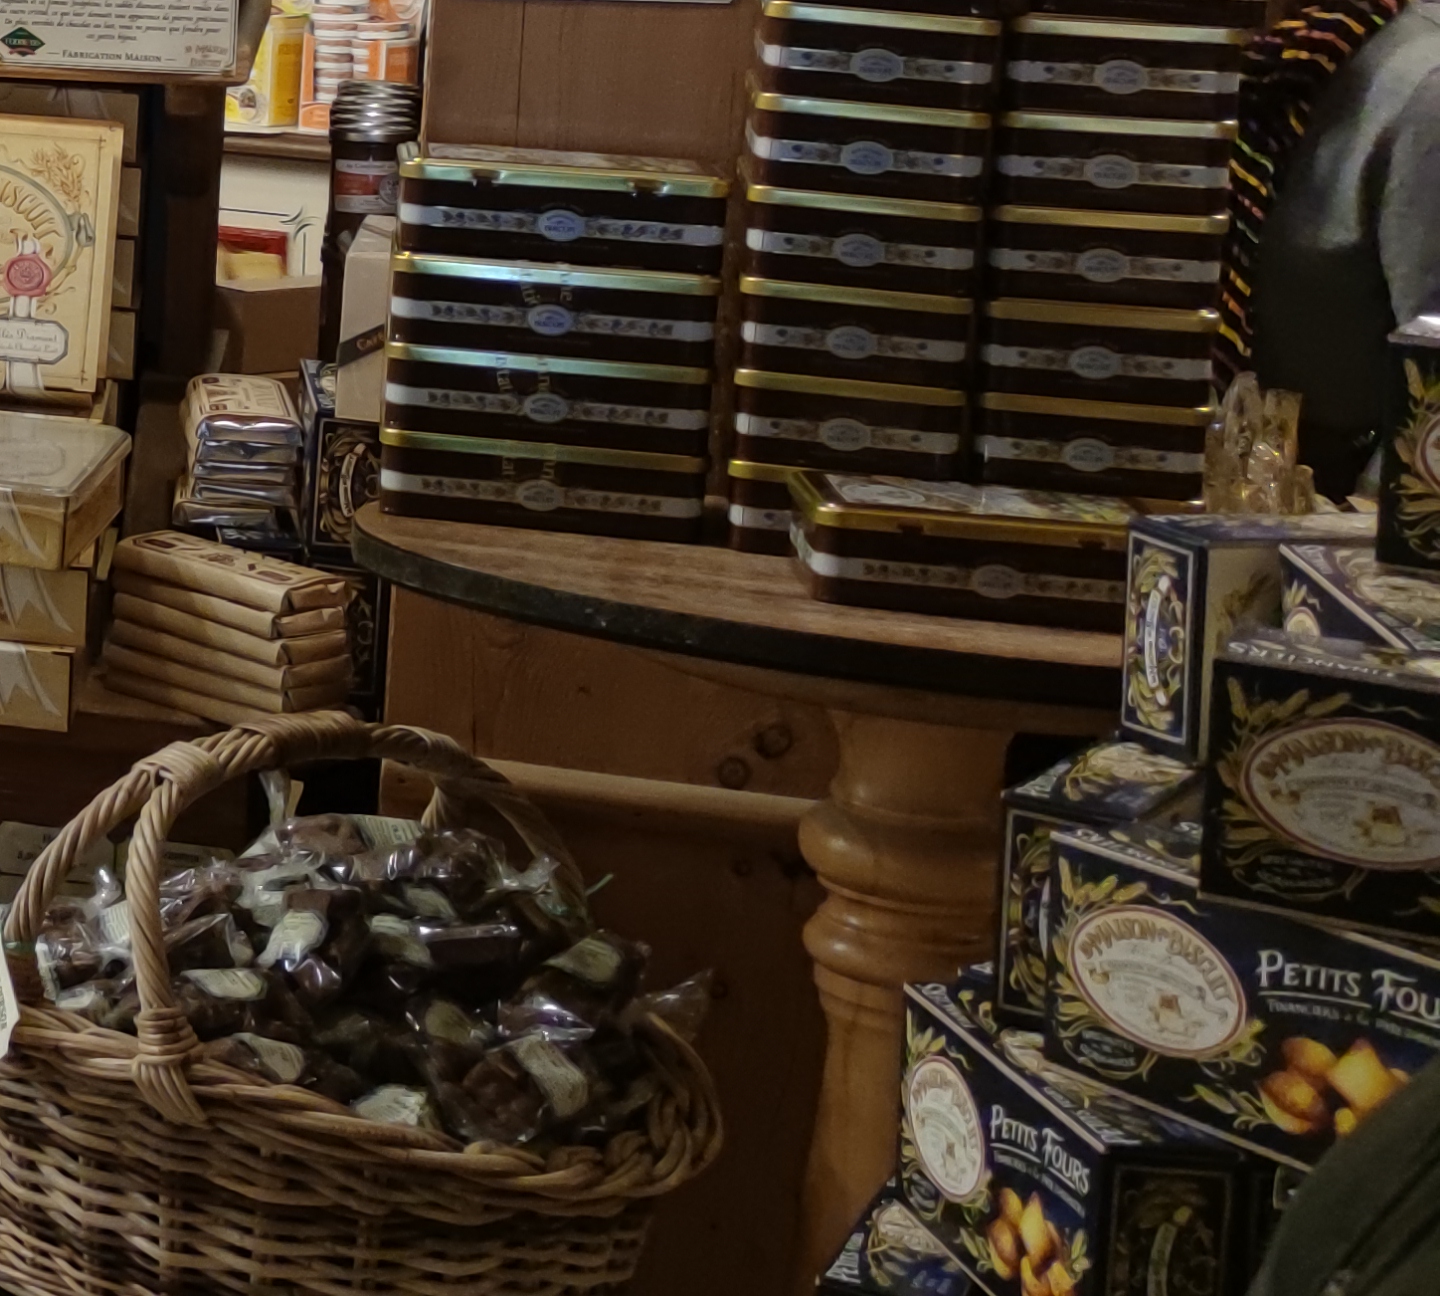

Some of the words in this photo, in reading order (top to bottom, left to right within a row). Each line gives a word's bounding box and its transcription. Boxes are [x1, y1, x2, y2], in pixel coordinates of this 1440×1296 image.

[61, 49, 119, 61] FABRICATION
[122, 50, 162, 63] MAISON
[1256, 949, 1361, 998] PETITS
[1371, 967, 1440, 1021] FOU
[988, 1104, 1040, 1156] PETITS
[1041, 1127, 1092, 1196] FOURS
